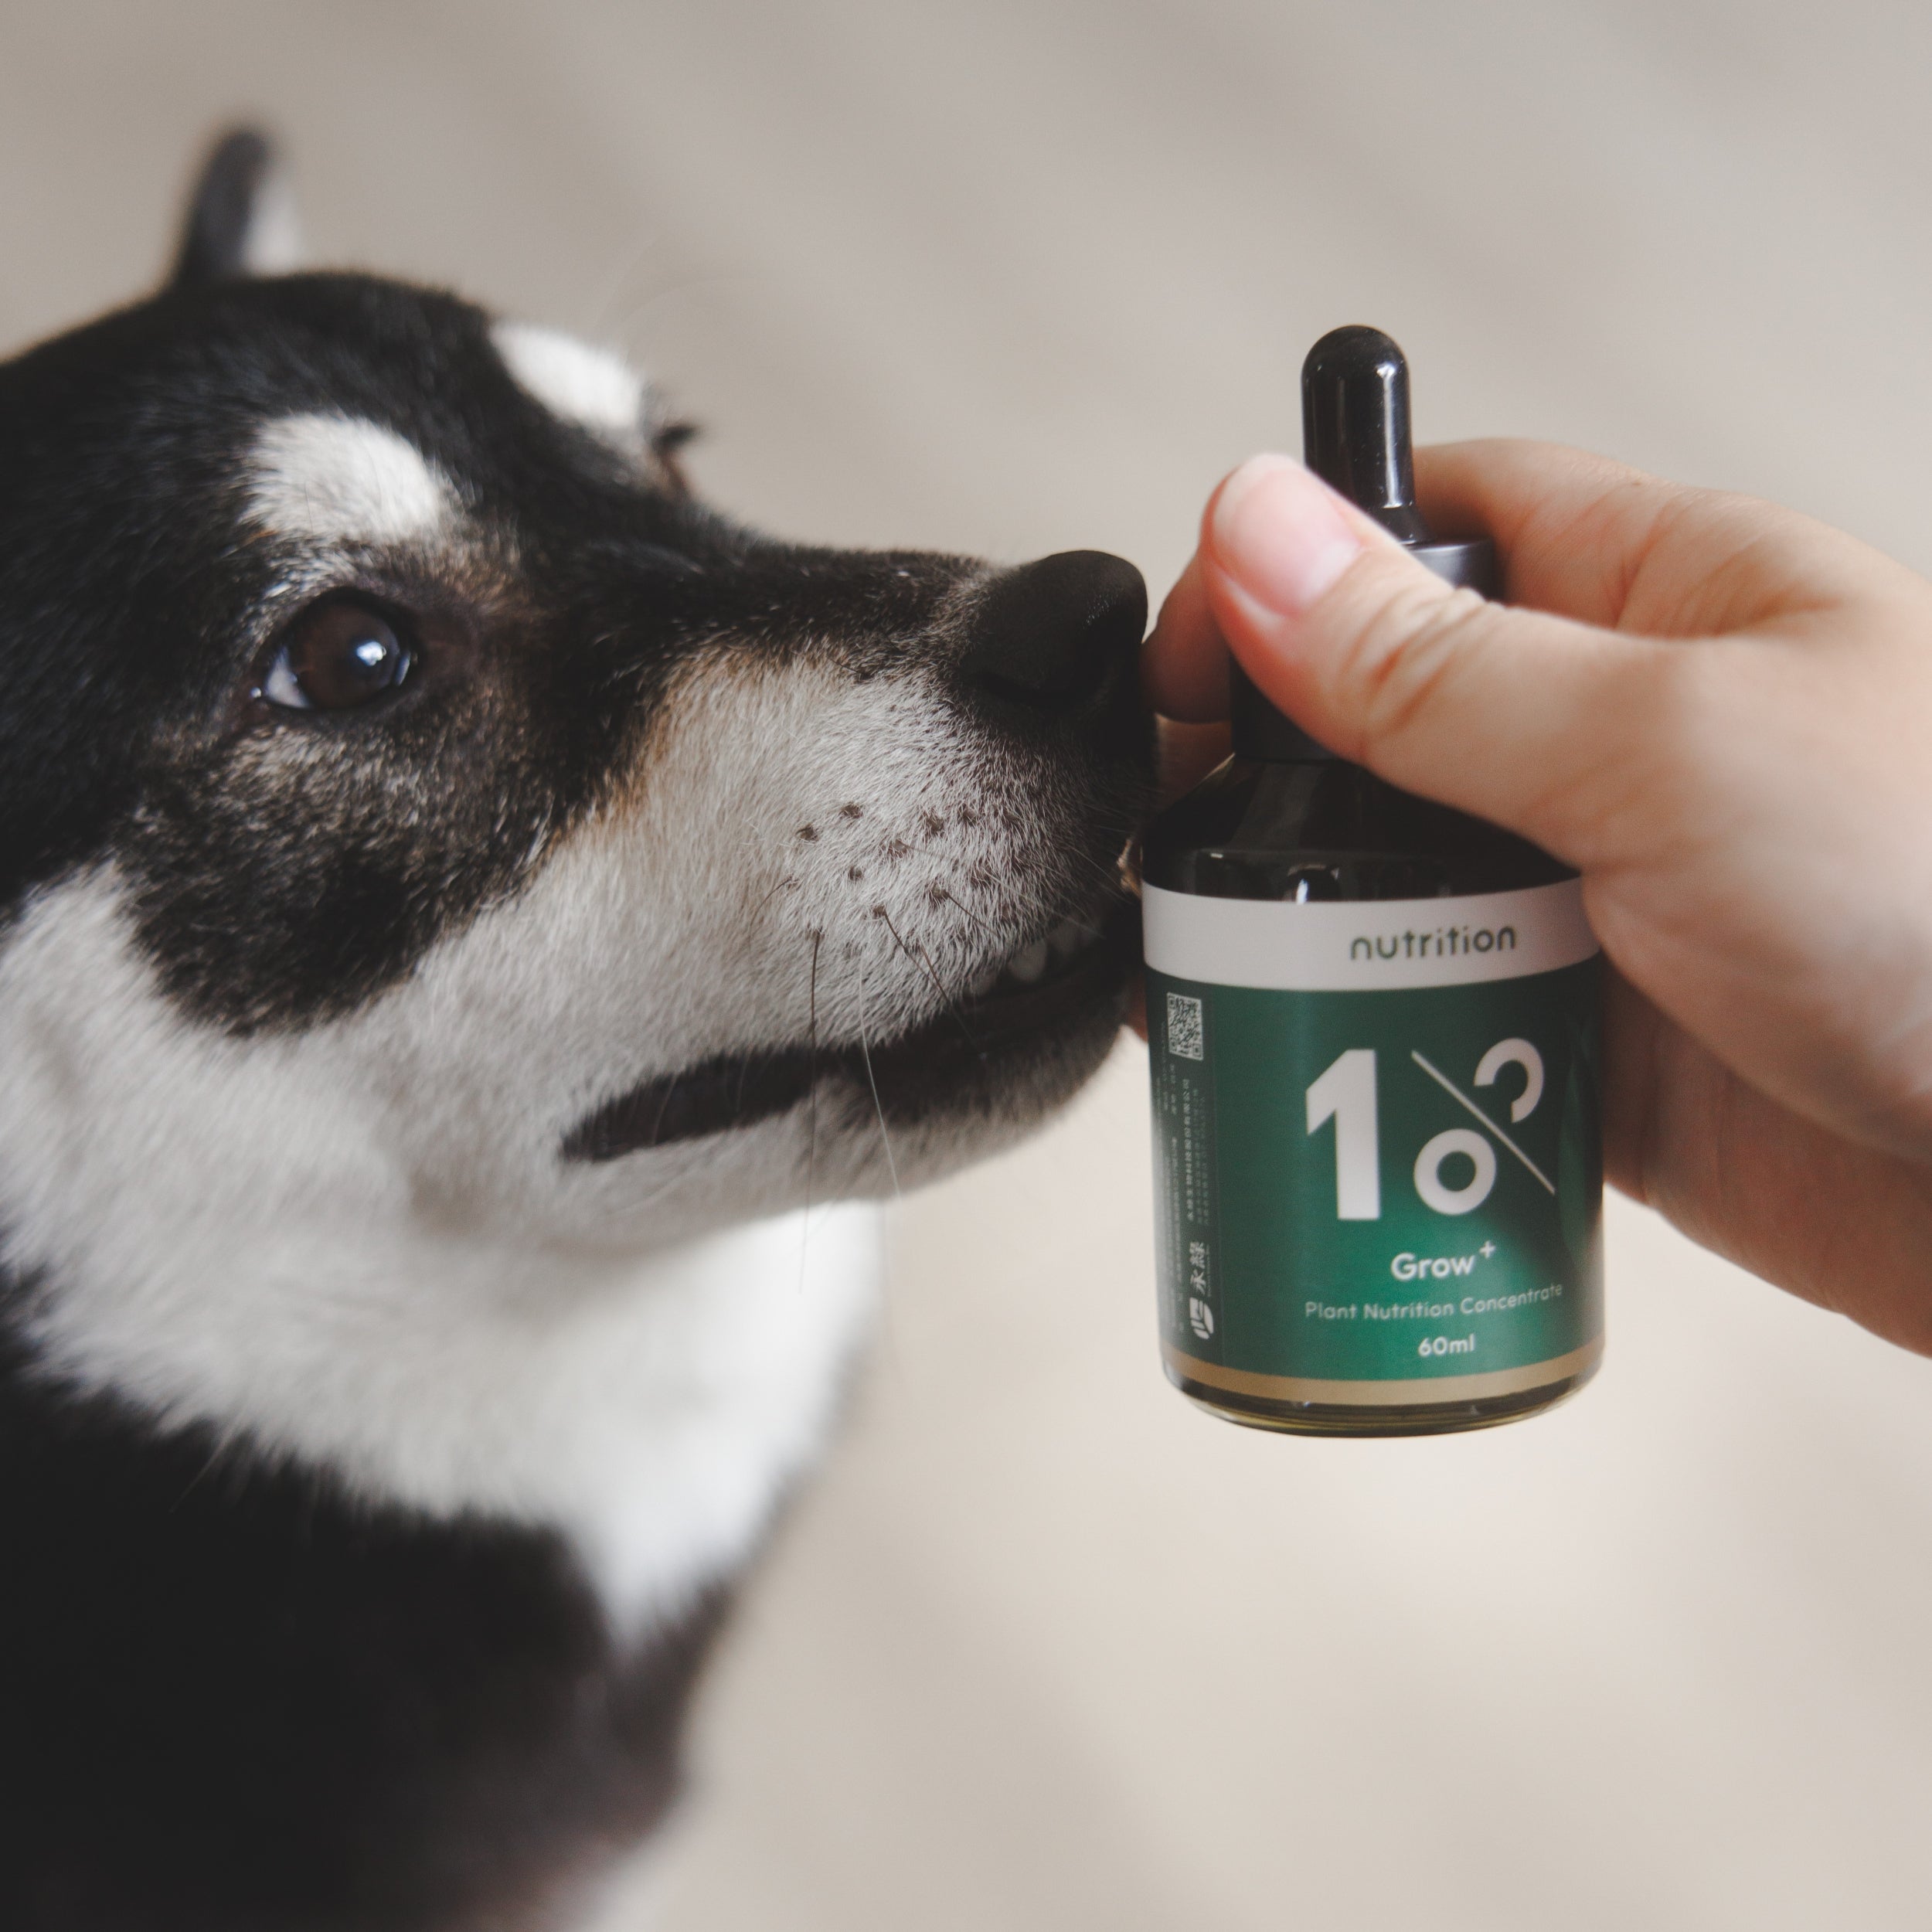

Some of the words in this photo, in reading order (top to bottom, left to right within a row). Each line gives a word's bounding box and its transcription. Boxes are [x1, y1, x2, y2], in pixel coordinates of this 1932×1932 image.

[1350, 926, 1516, 961] nutrition
[1304, 1301, 1356, 1320] Plant
[1363, 1300, 1454, 1320] Nutrition
[1460, 1283, 1563, 1315] Concentrate
[1417, 1334, 1475, 1358] 60ml
